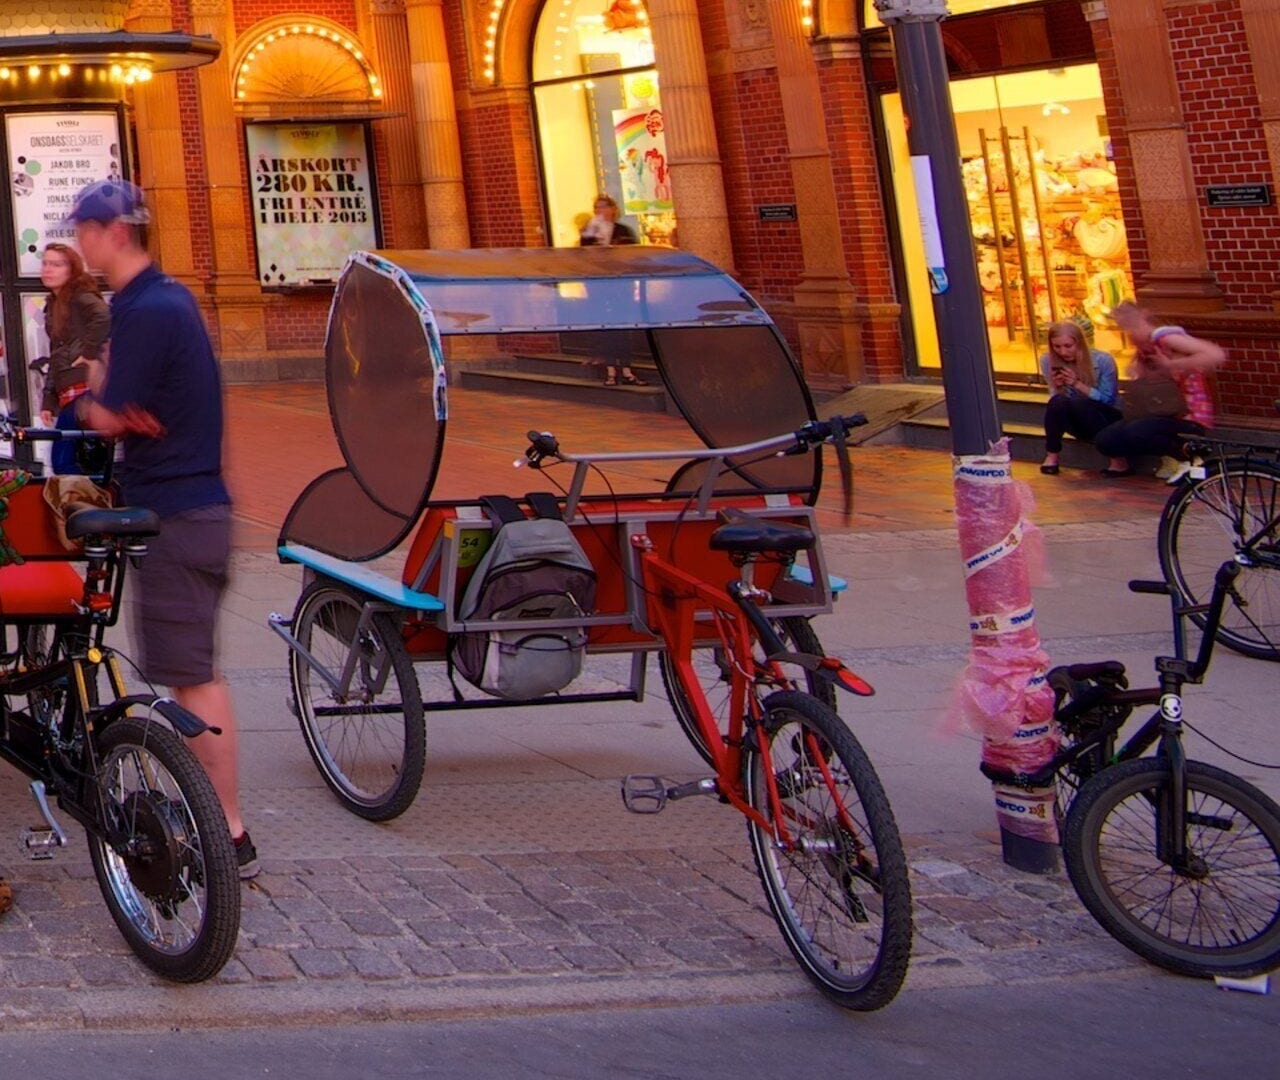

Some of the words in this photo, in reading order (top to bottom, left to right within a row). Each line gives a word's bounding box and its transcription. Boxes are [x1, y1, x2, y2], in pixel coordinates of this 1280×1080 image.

[291, 128, 320, 138] TIVOLI
[50, 161, 73, 169] JAKOB
[256, 154, 361, 172] ÅRSKORT
[256, 174, 307, 193] 280
[313, 173, 363, 192] KR.
[259, 197, 295, 210] FRI
[300, 193, 367, 210] ENTRÉ
[273, 212, 323, 223] HELE
[328, 211, 367, 223] 2013
